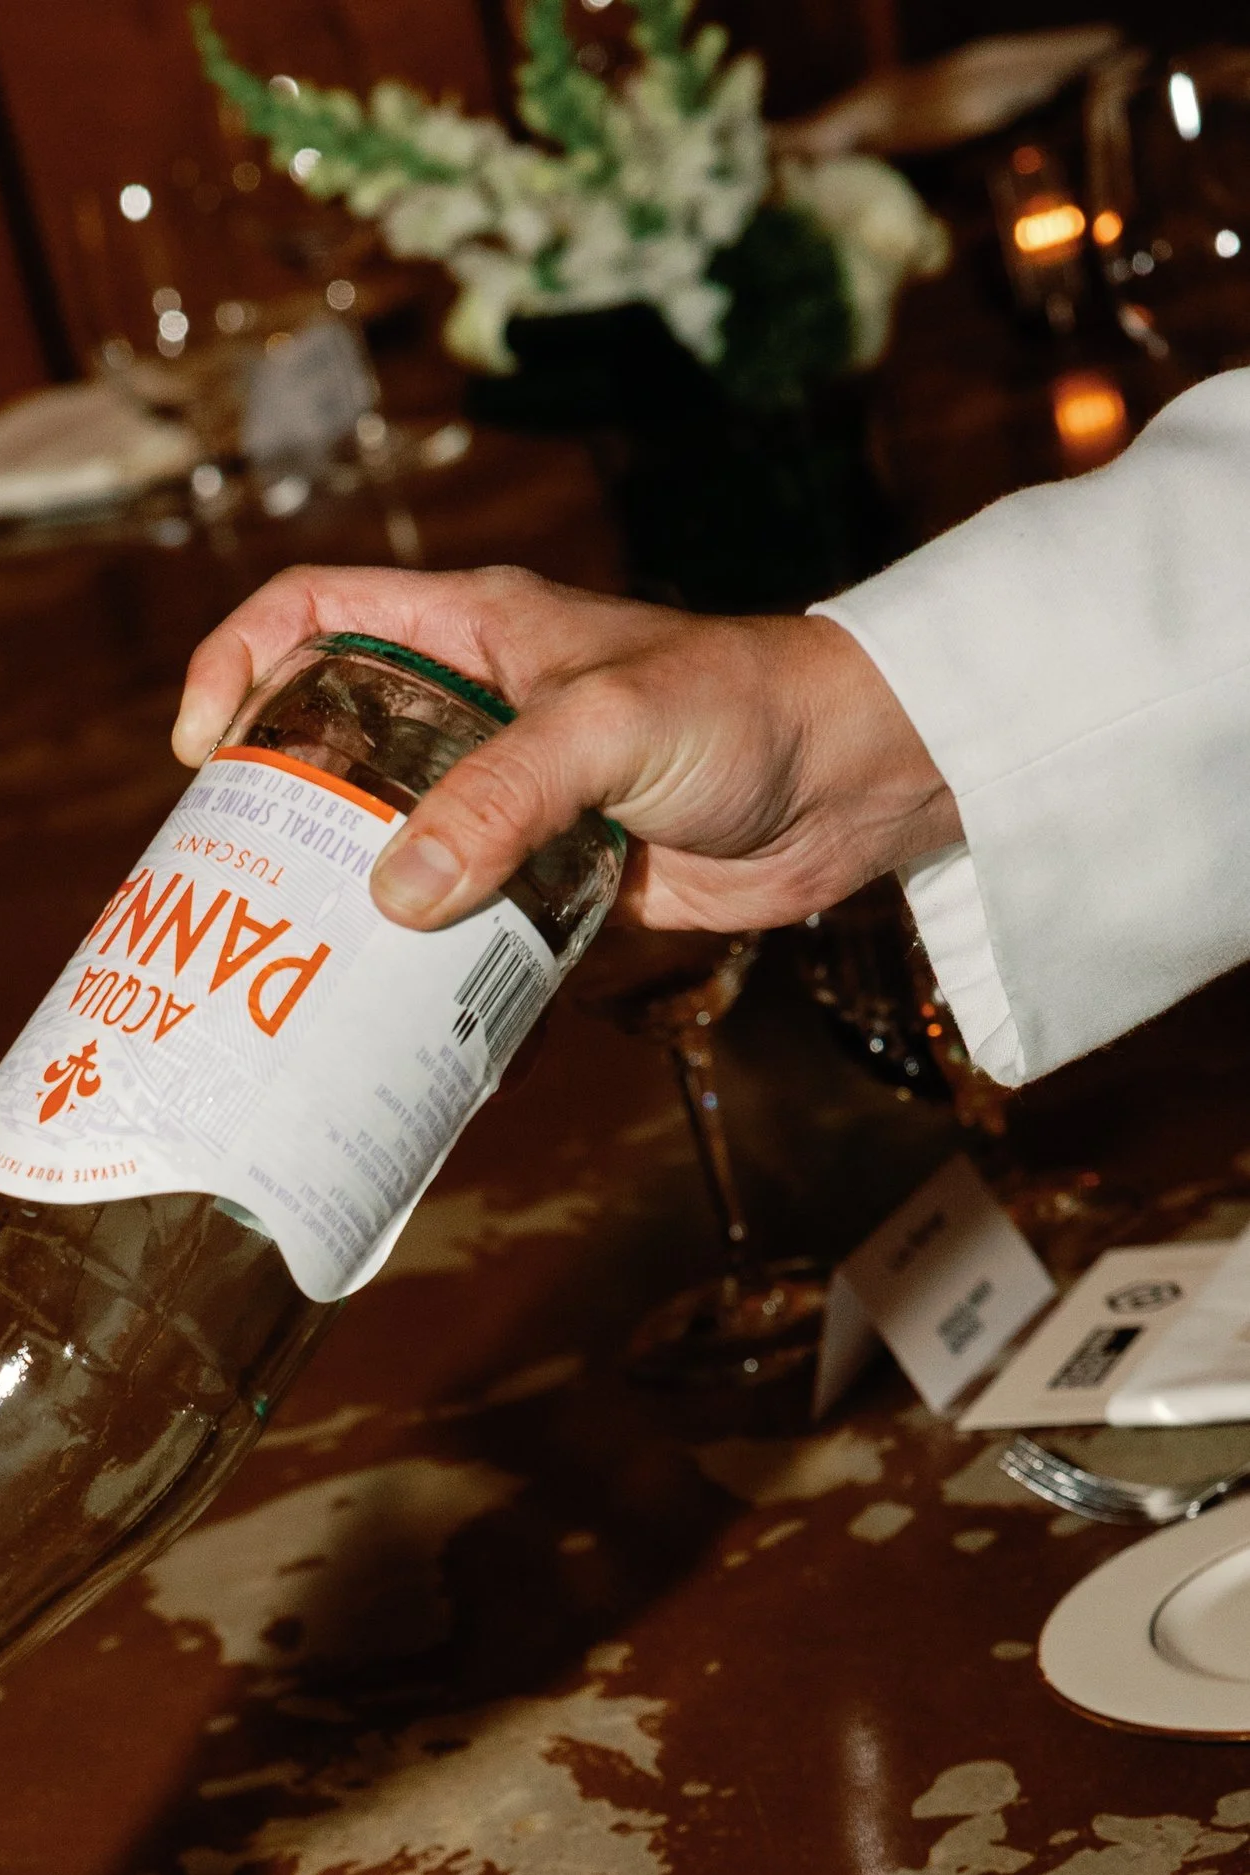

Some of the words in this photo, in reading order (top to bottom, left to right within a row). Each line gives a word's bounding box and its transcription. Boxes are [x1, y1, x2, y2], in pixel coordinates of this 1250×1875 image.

[281, 780, 304, 799] OZ
[306, 789, 325, 809] FL
[211, 788, 279, 826] SPRING
[326, 804, 364, 831] 33.8
[279, 808, 375, 877] NATURAL
[173, 832, 286, 886] TUSCANY
[84, 868, 332, 1038] PANNA
[68, 966, 196, 1043] ACQUA
[26, 1165, 64, 1183] YOUR
[73, 1159, 138, 1183] ELEVATE
